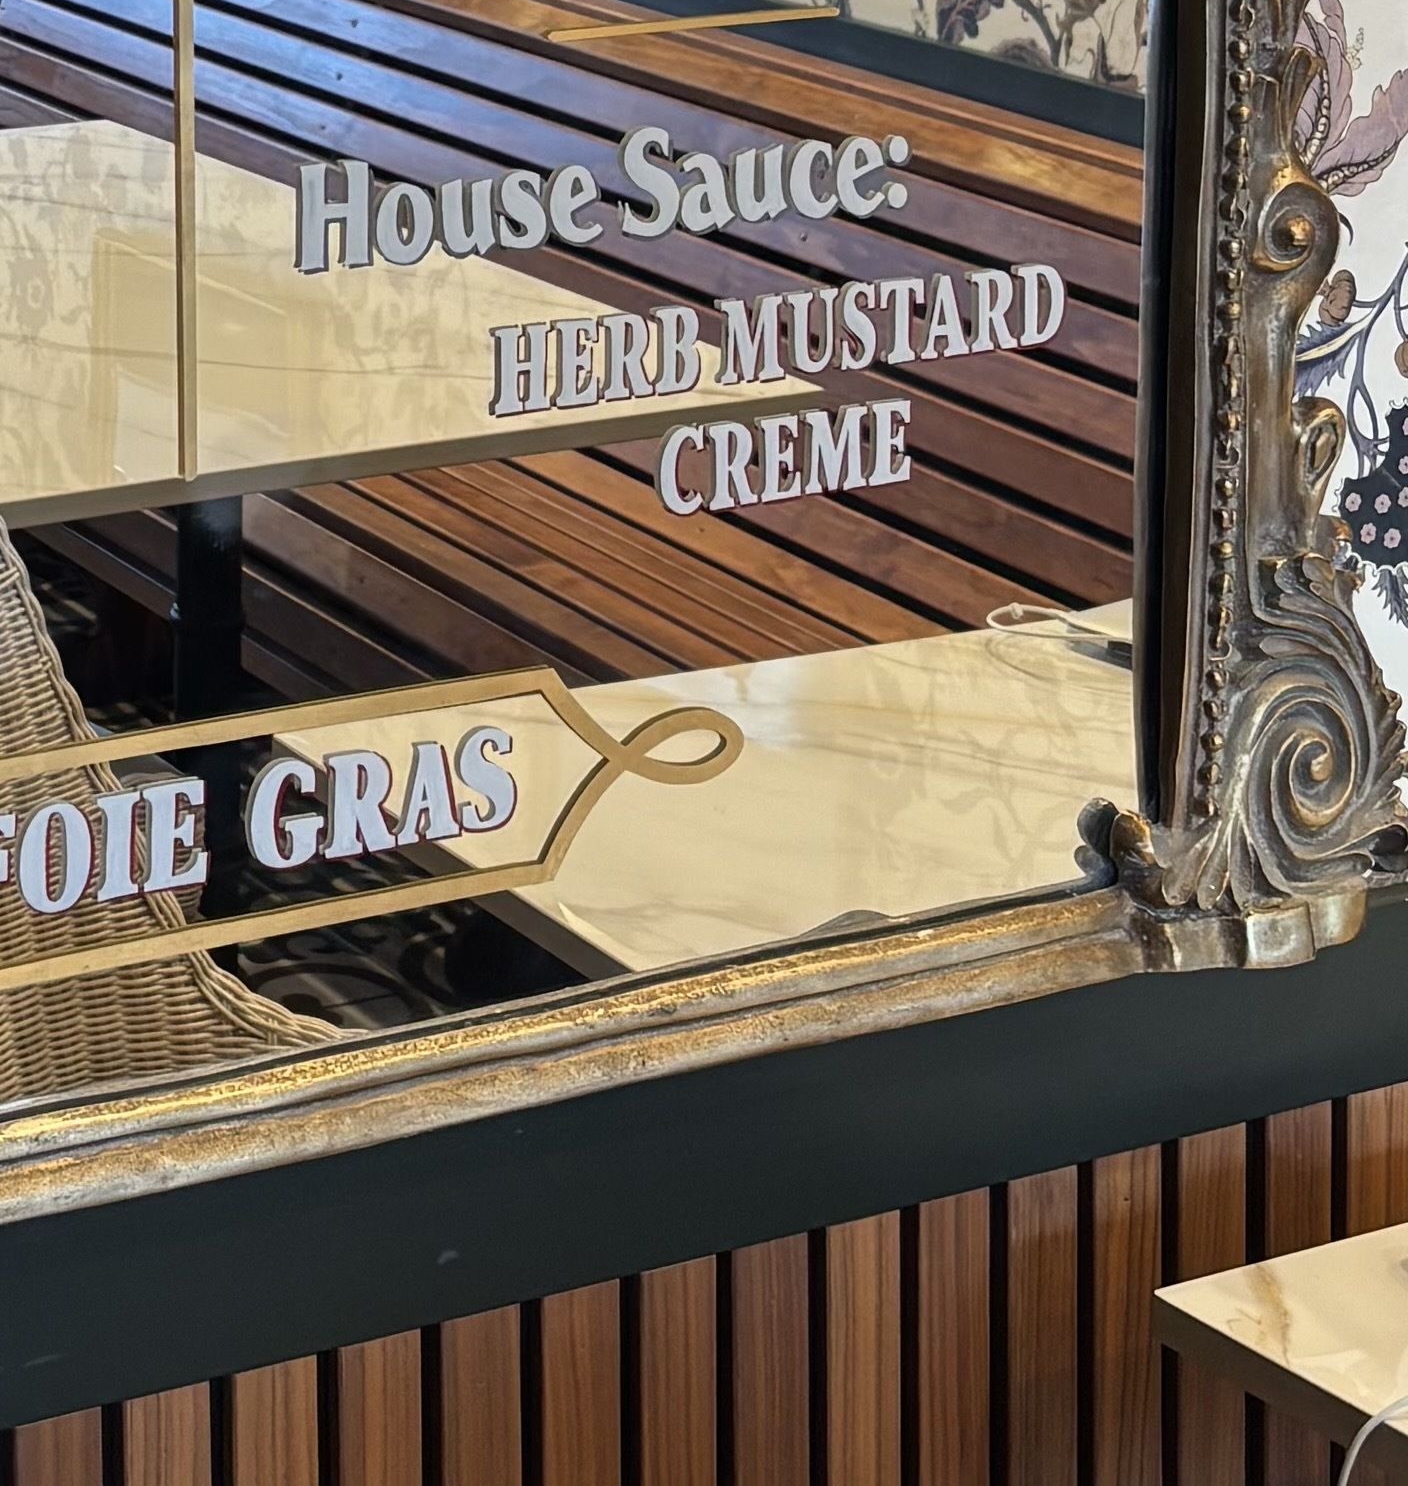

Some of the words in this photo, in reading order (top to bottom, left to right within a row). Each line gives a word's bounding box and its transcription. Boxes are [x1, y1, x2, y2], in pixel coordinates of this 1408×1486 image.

[294, 159, 602, 274] House
[615, 125, 913, 241] Sauce:
[488, 304, 702, 416] HERB
[712, 263, 1066, 386] MUSTARD
[654, 398, 913, 516] CREME
[246, 725, 519, 870] GRAS
